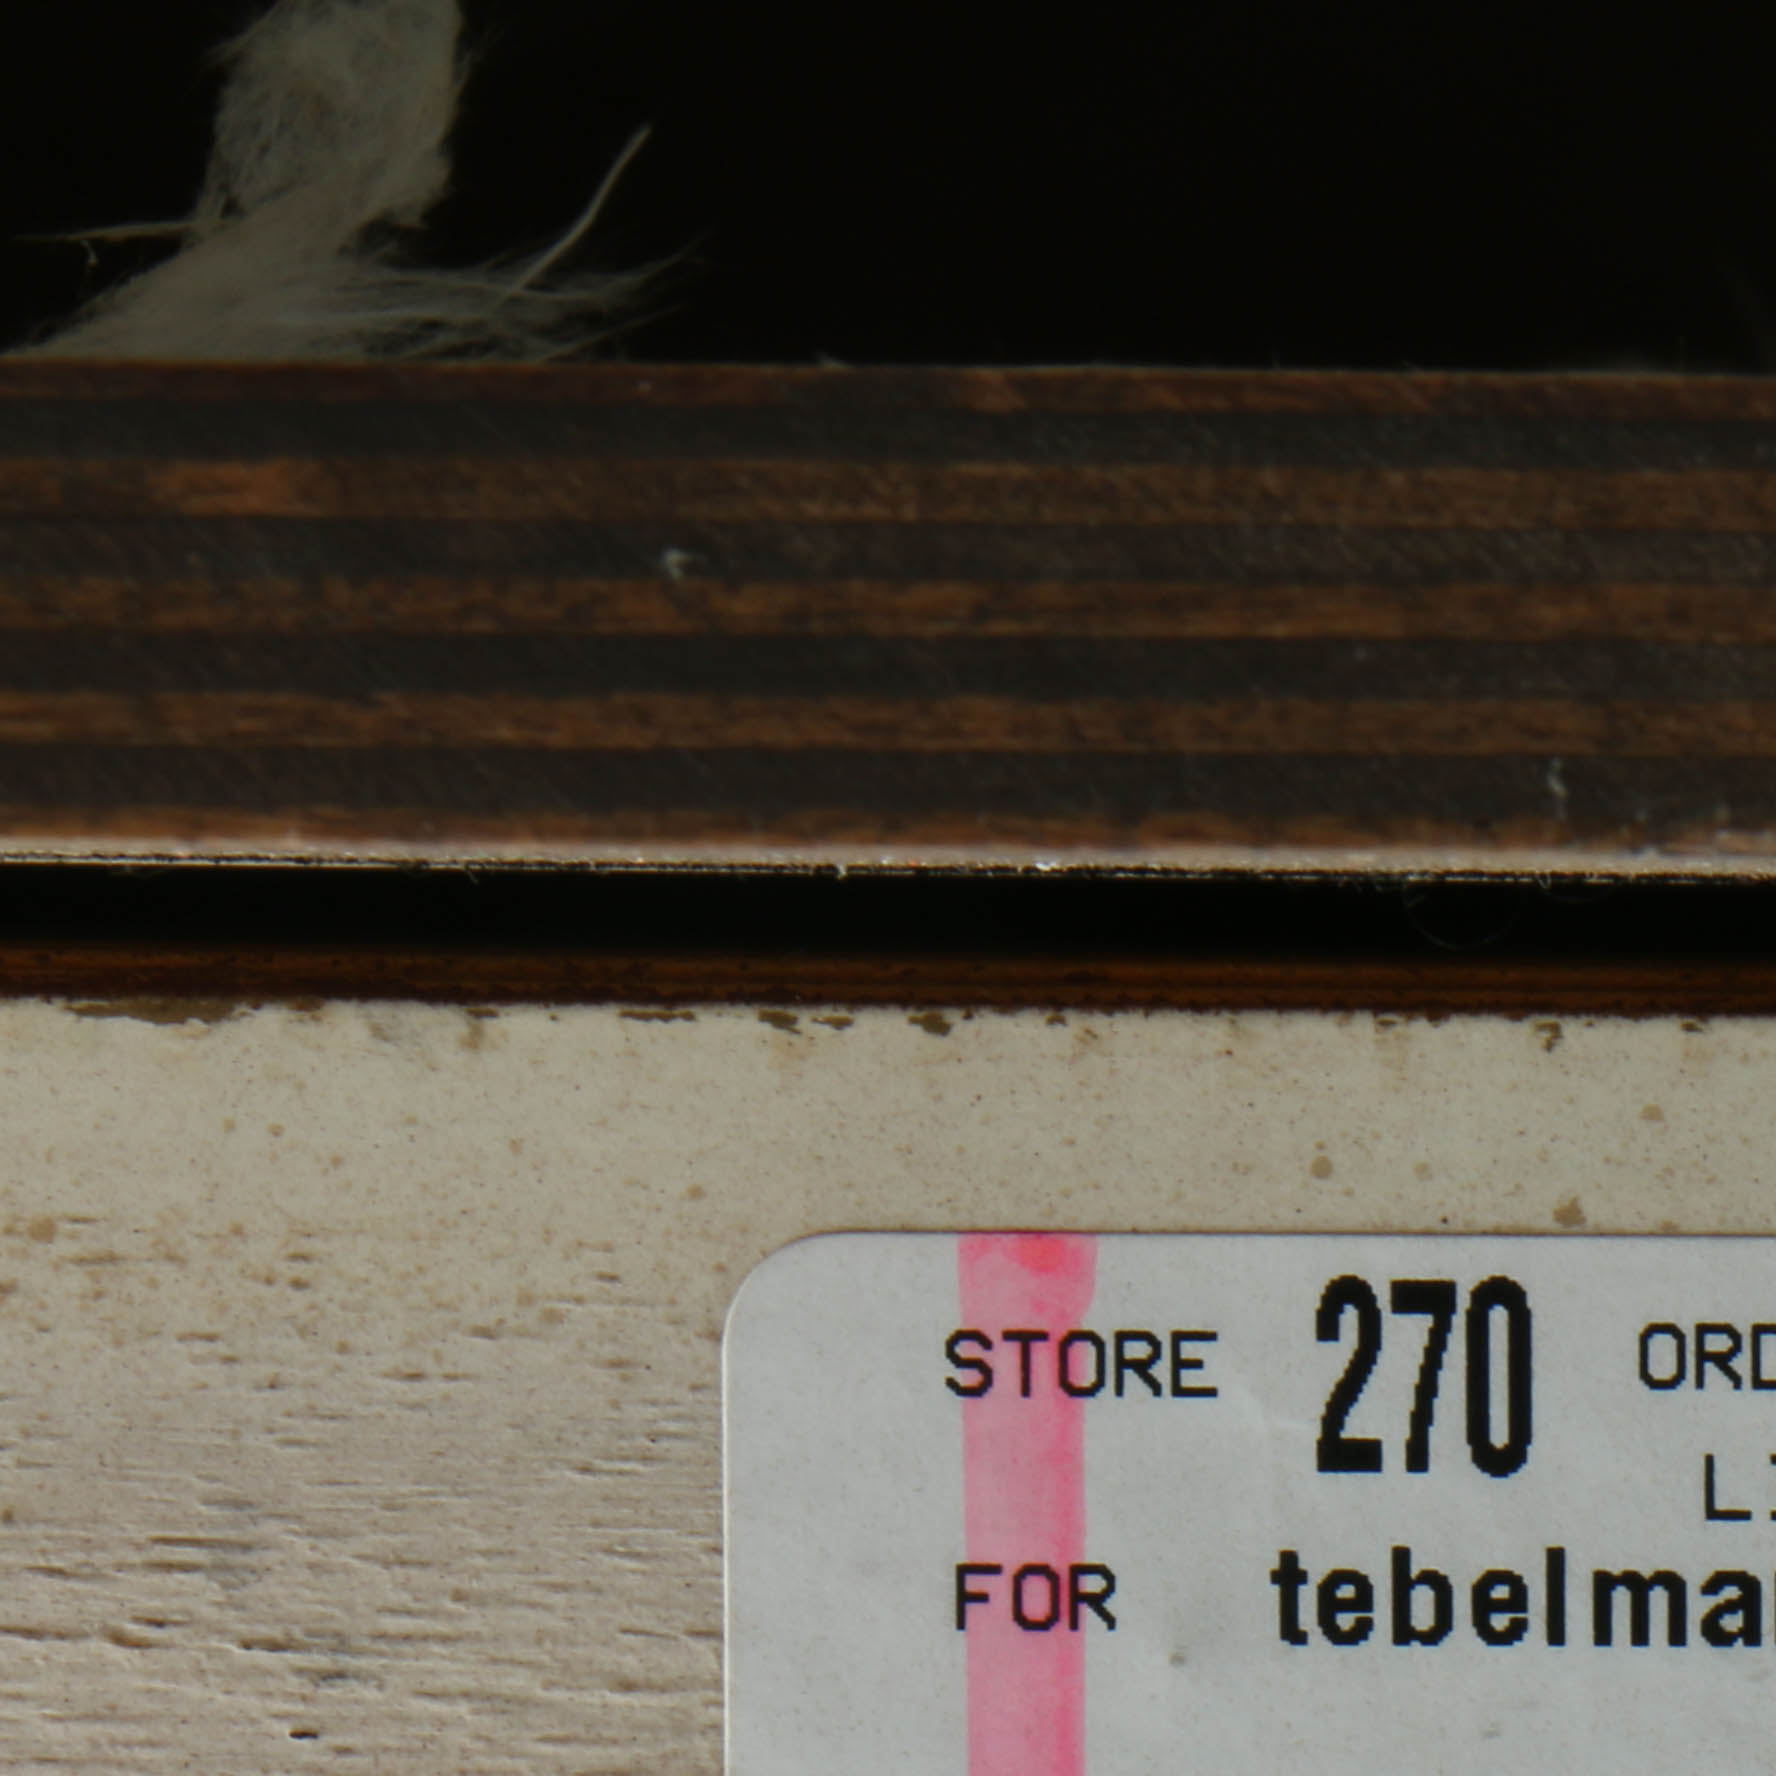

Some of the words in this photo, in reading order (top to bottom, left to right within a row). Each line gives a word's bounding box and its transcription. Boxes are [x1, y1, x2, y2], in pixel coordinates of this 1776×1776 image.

[946, 1331, 1218, 1397] STORE
[1315, 1275, 1533, 1478] 270
[956, 1564, 1116, 1631] FOR
